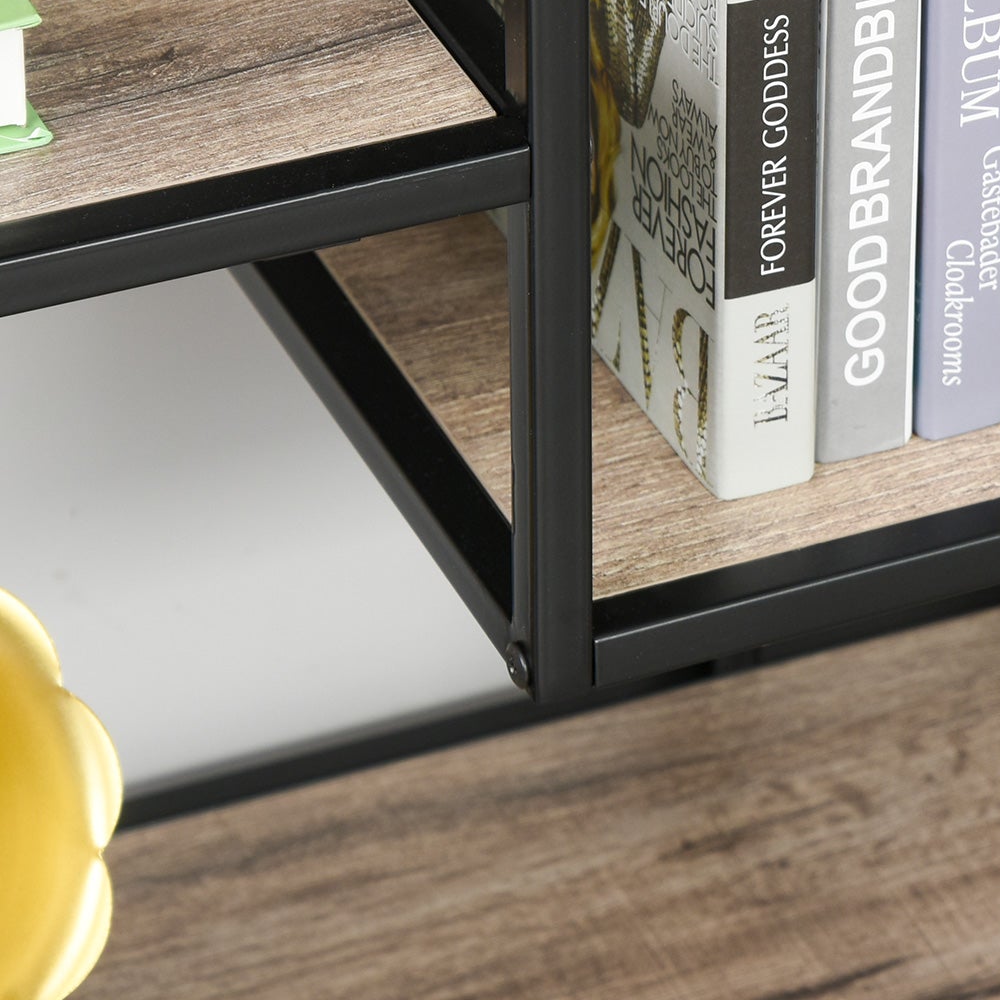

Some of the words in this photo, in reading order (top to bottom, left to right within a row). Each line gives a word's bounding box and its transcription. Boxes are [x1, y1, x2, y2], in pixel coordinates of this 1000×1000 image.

[692, 35, 719, 86] THE
[761, 14, 790, 149] GODDESS
[647, 100, 681, 153] NOW
[671, 102, 705, 155] WEAR
[672, 77, 717, 142] ALWAYS
[656, 137, 694, 188] LOOKS
[680, 138, 701, 174] BUY
[701, 164, 717, 198] TO
[631, 132, 715, 268] FASHION
[696, 180, 717, 224] THE
[760, 155, 787, 276] FOREVER
[631, 177, 715, 311] FOREVER
[940, 239, 974, 387] Cloakrooms
